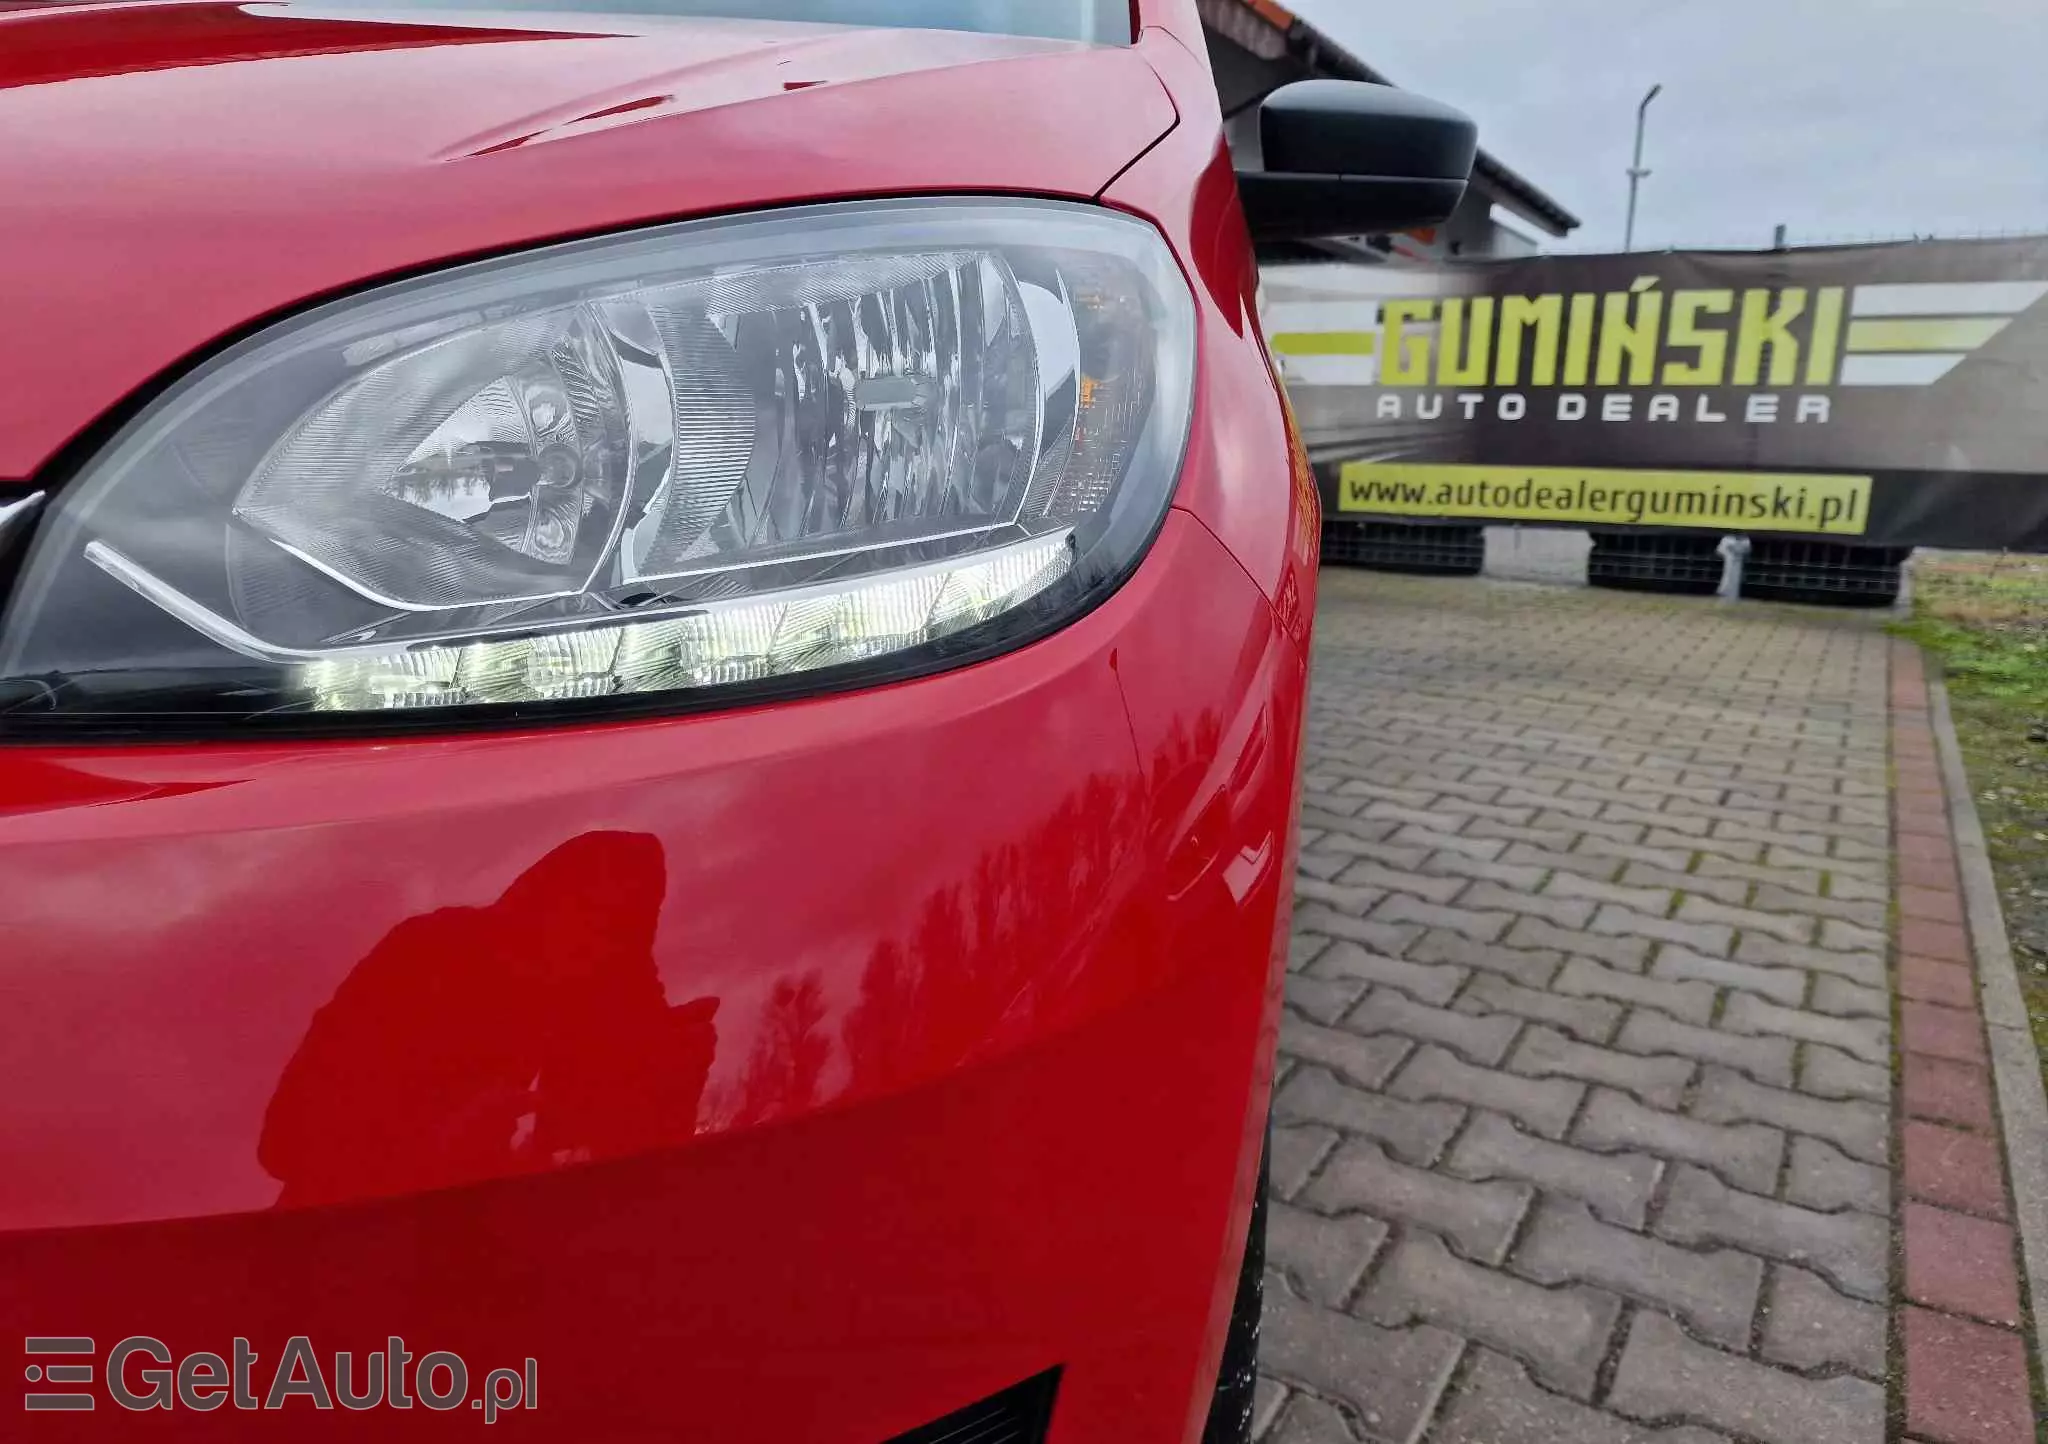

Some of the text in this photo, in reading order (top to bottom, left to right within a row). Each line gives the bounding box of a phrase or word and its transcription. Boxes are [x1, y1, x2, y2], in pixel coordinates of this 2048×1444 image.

[1377, 276, 1847, 387] GUMIŃSKI
[1376, 394, 1831, 424] AUTO DEALER
[1350, 477, 1858, 529] www.autodealerguminski.pl
